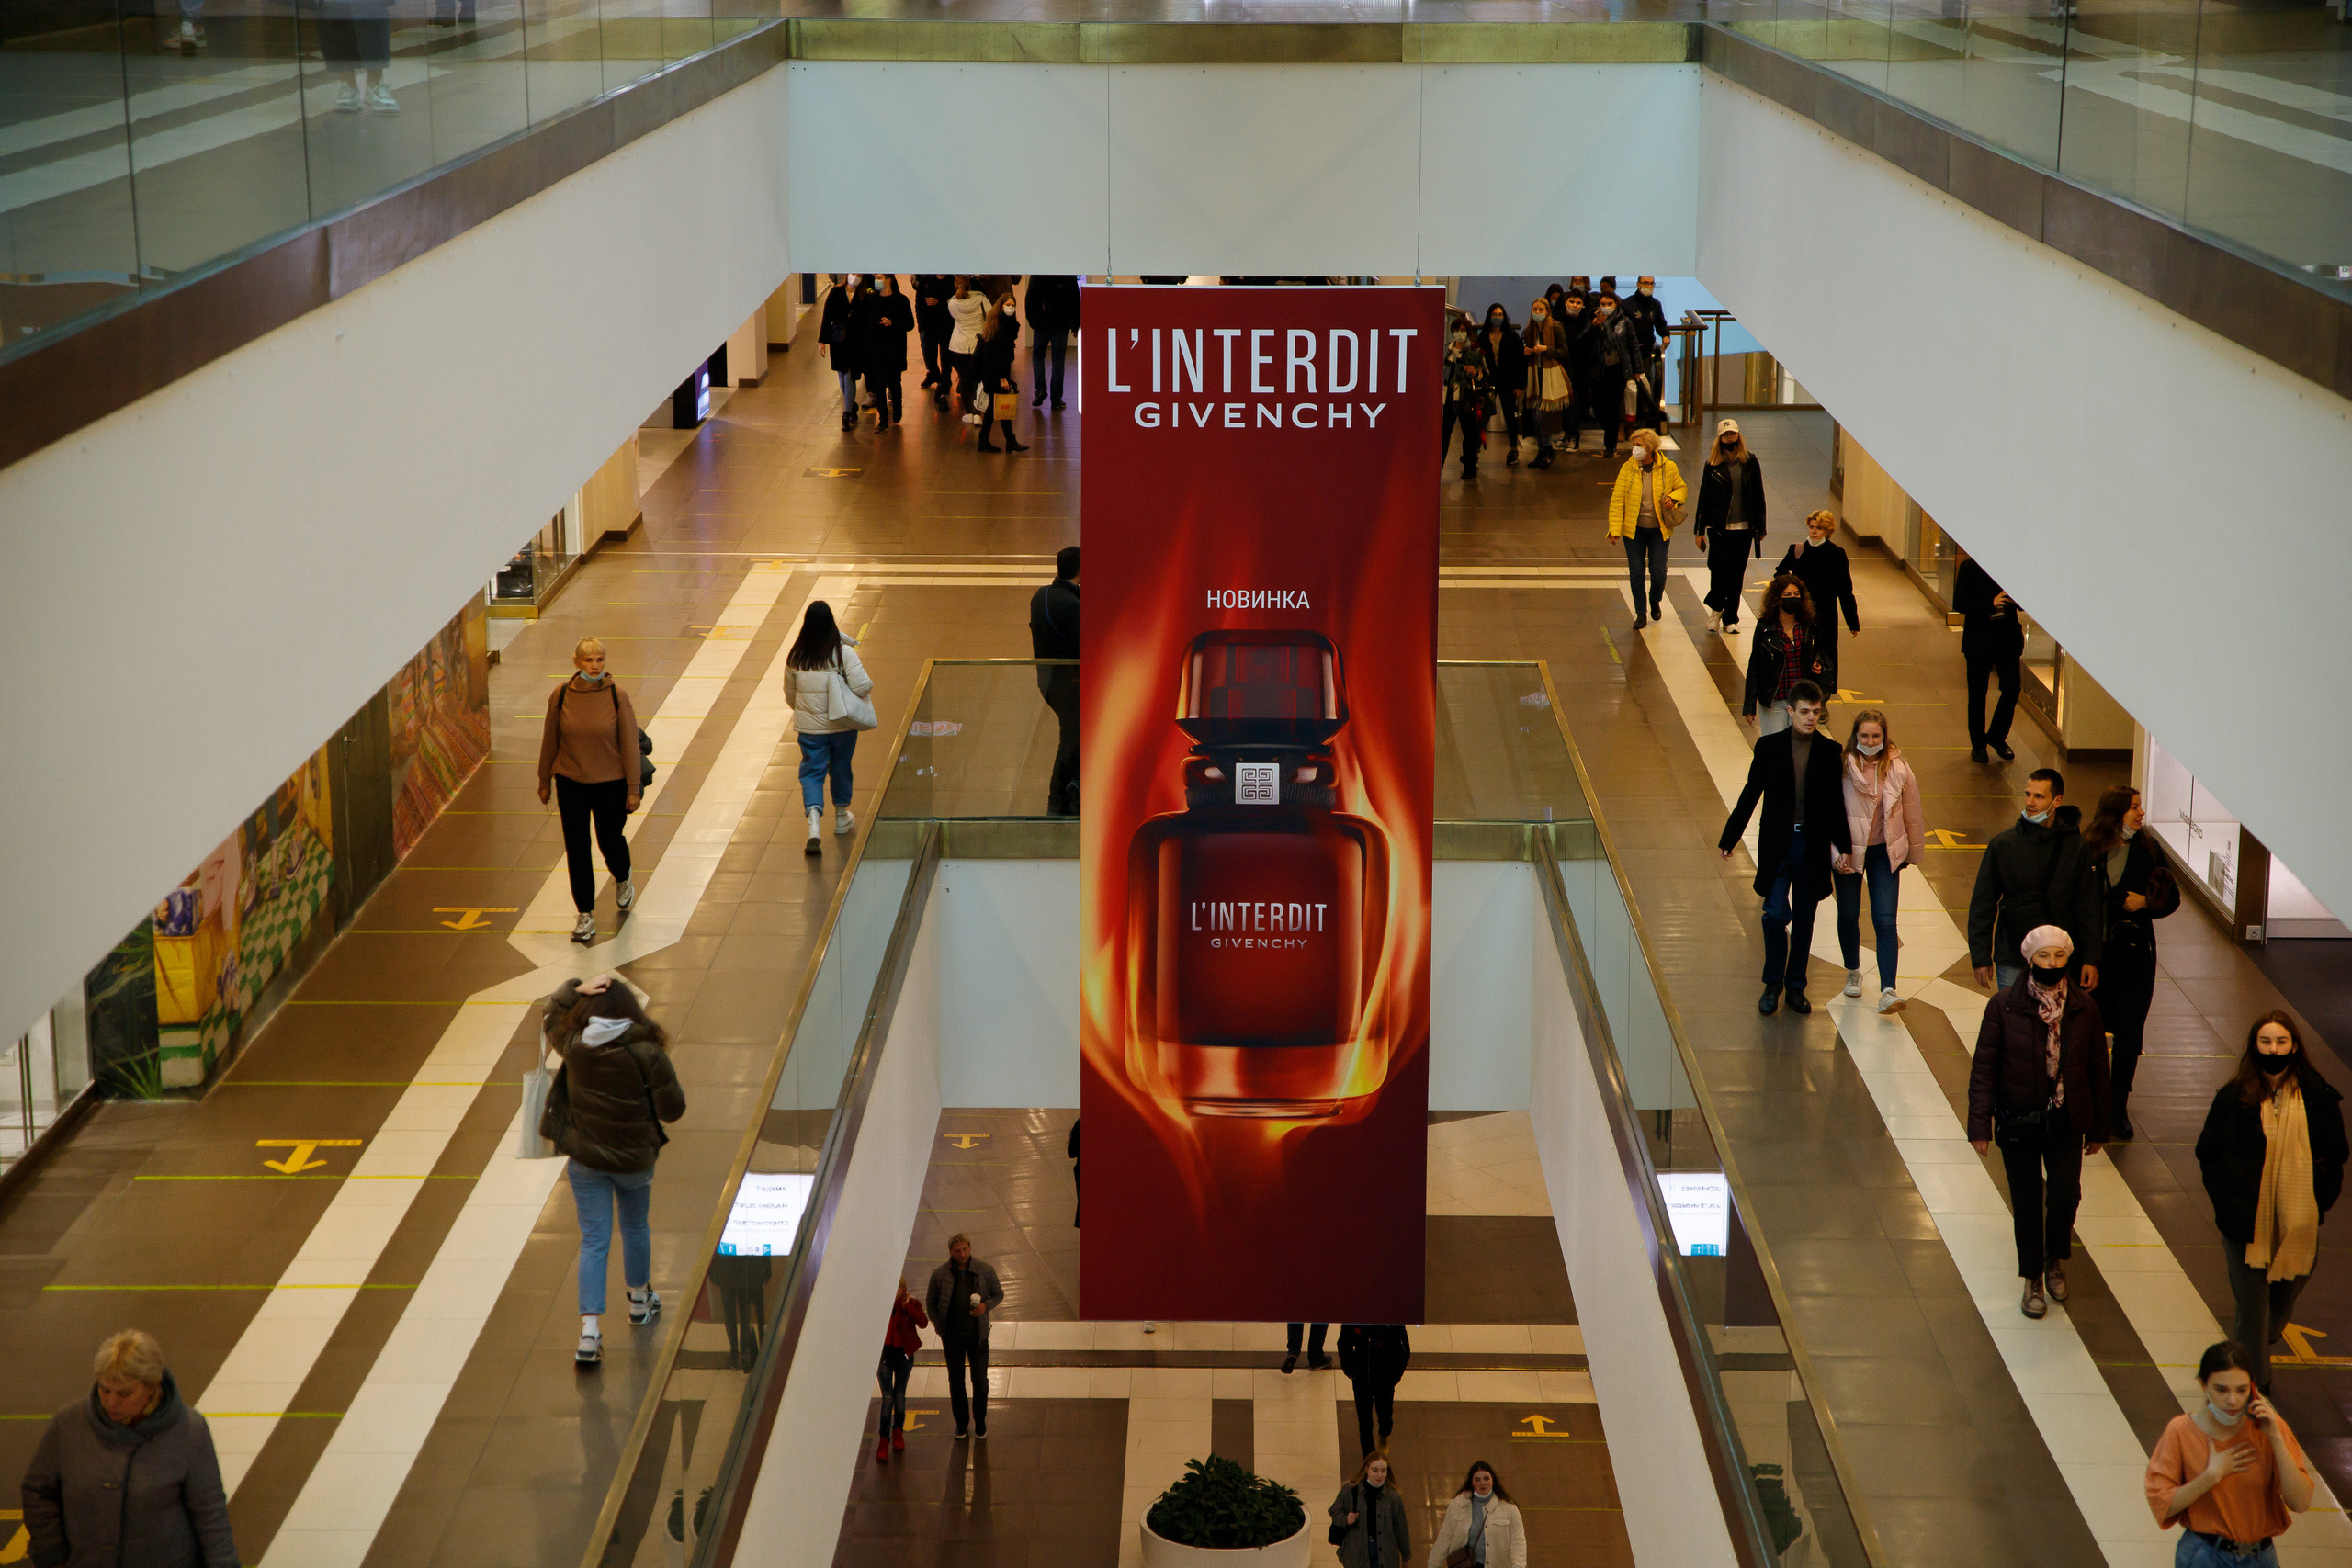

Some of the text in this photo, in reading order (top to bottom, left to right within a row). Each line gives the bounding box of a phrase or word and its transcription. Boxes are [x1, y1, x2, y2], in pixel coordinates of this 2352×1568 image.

[1108, 328, 1418, 393] L'INTERDIT
[1134, 401, 1387, 428] GIVENCHY
[1207, 589, 1311, 609] НОВИНКА
[1192, 902, 1328, 932] L'INTERDIT
[1210, 938, 1307, 949] GIVENCHY
